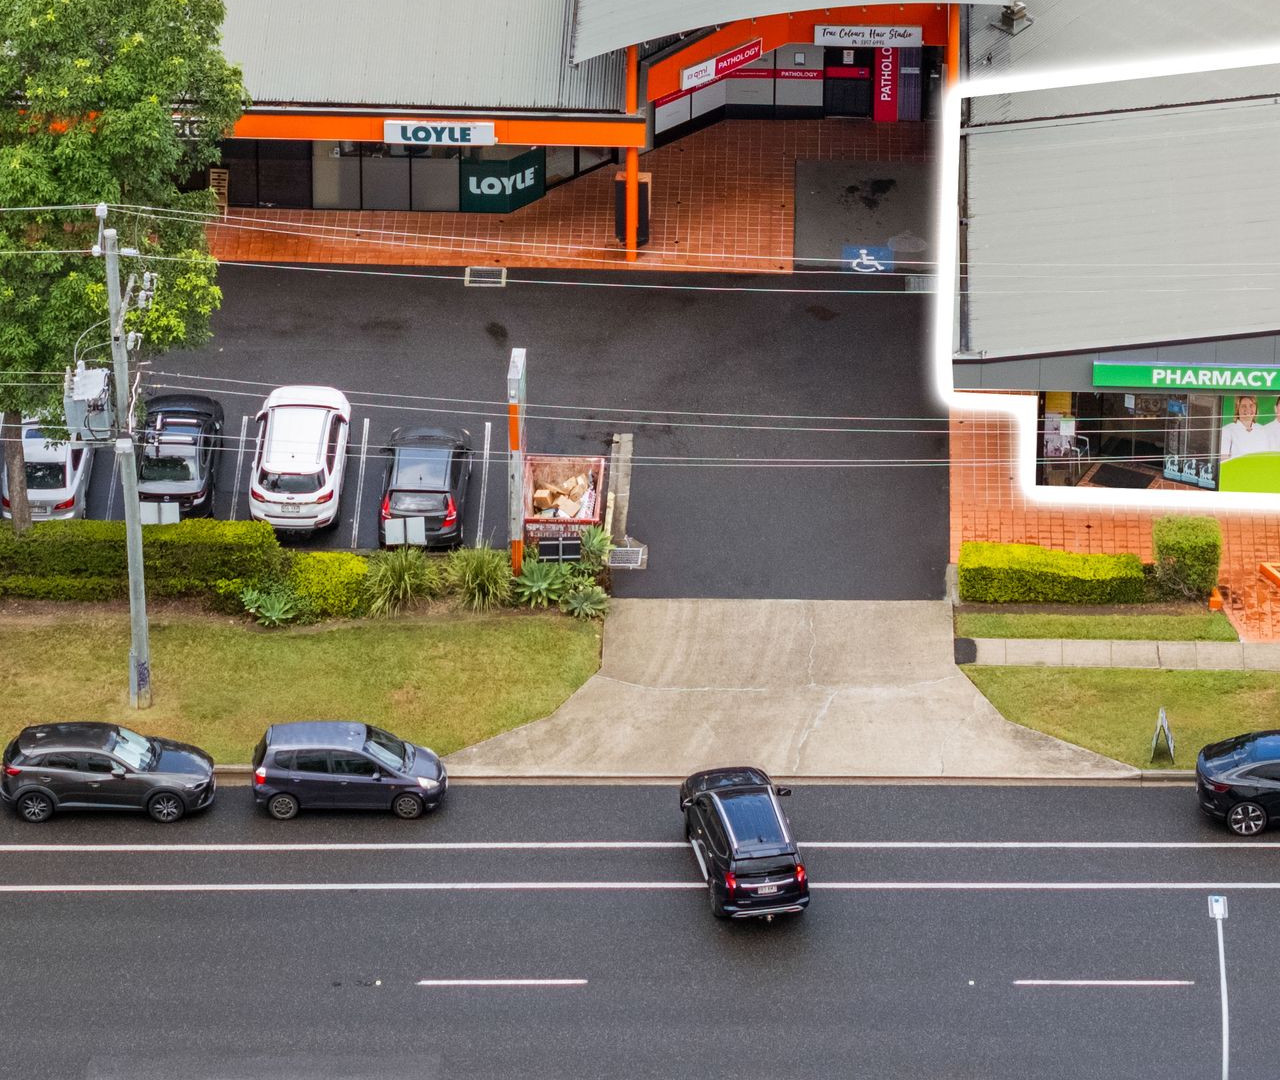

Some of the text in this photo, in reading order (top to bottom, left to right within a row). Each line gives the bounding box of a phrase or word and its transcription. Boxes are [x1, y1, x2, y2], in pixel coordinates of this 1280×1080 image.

[839, 27, 865, 39] Colours
[869, 28, 887, 39] Hair
[889, 28, 913, 40] Studio
[718, 45, 760, 70] PATHOLOGY
[400, 125, 472, 143] LOYLE
[469, 167, 535, 195] LOYLE
[1151, 368, 1278, 387] PHARMACY
